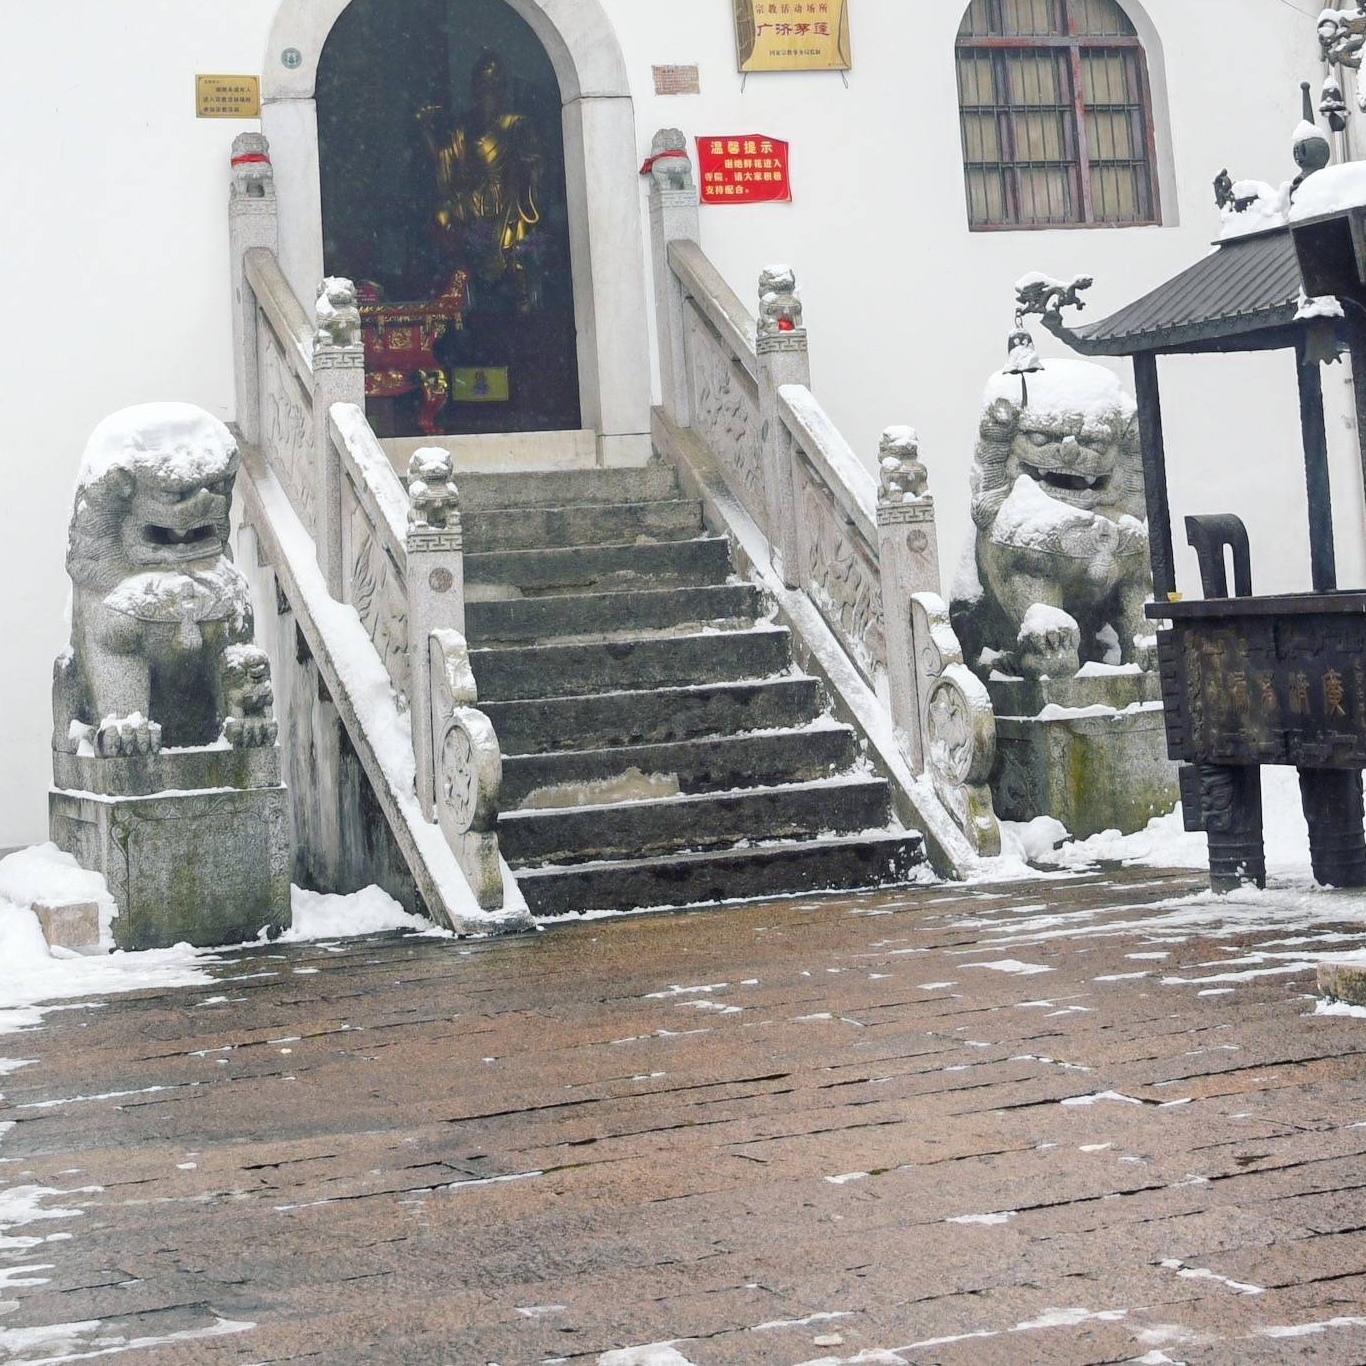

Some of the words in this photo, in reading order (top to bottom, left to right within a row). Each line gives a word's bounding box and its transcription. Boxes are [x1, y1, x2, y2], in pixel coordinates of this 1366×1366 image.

[756, 3, 827, 14] 宗教活动场所
[710, 140, 773, 154] 温馨提示
